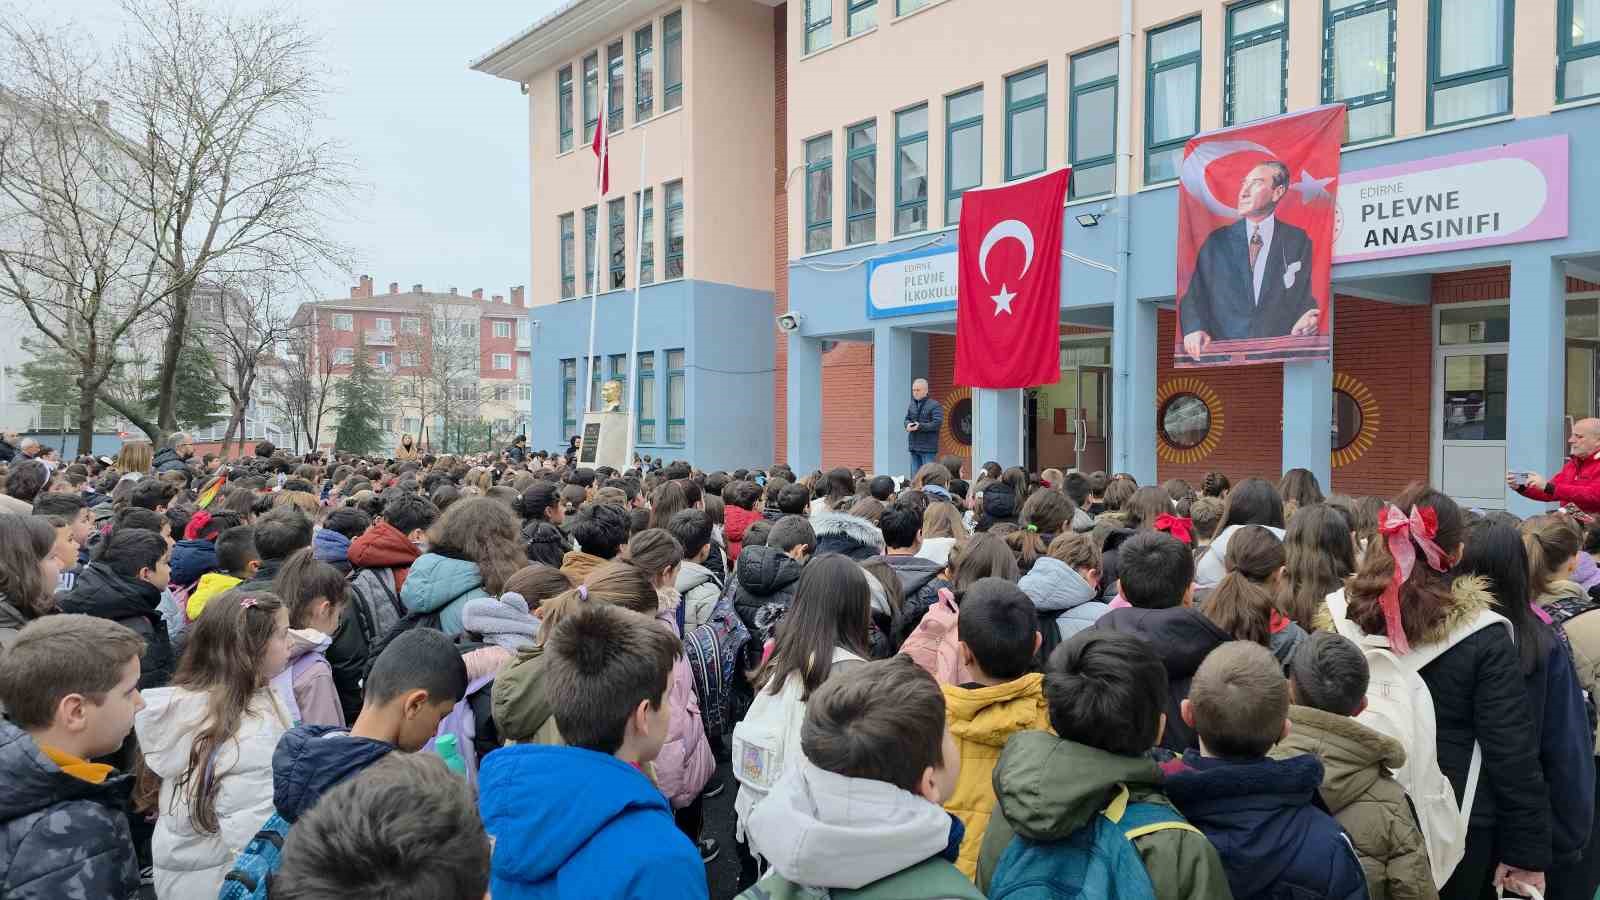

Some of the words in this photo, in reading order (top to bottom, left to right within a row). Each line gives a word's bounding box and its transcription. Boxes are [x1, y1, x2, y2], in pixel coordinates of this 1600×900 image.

[1361, 190, 1460, 223] PLEVNE
[1363, 211, 1501, 248] ANASINIFI
[904, 271, 945, 288] PLEVNE
